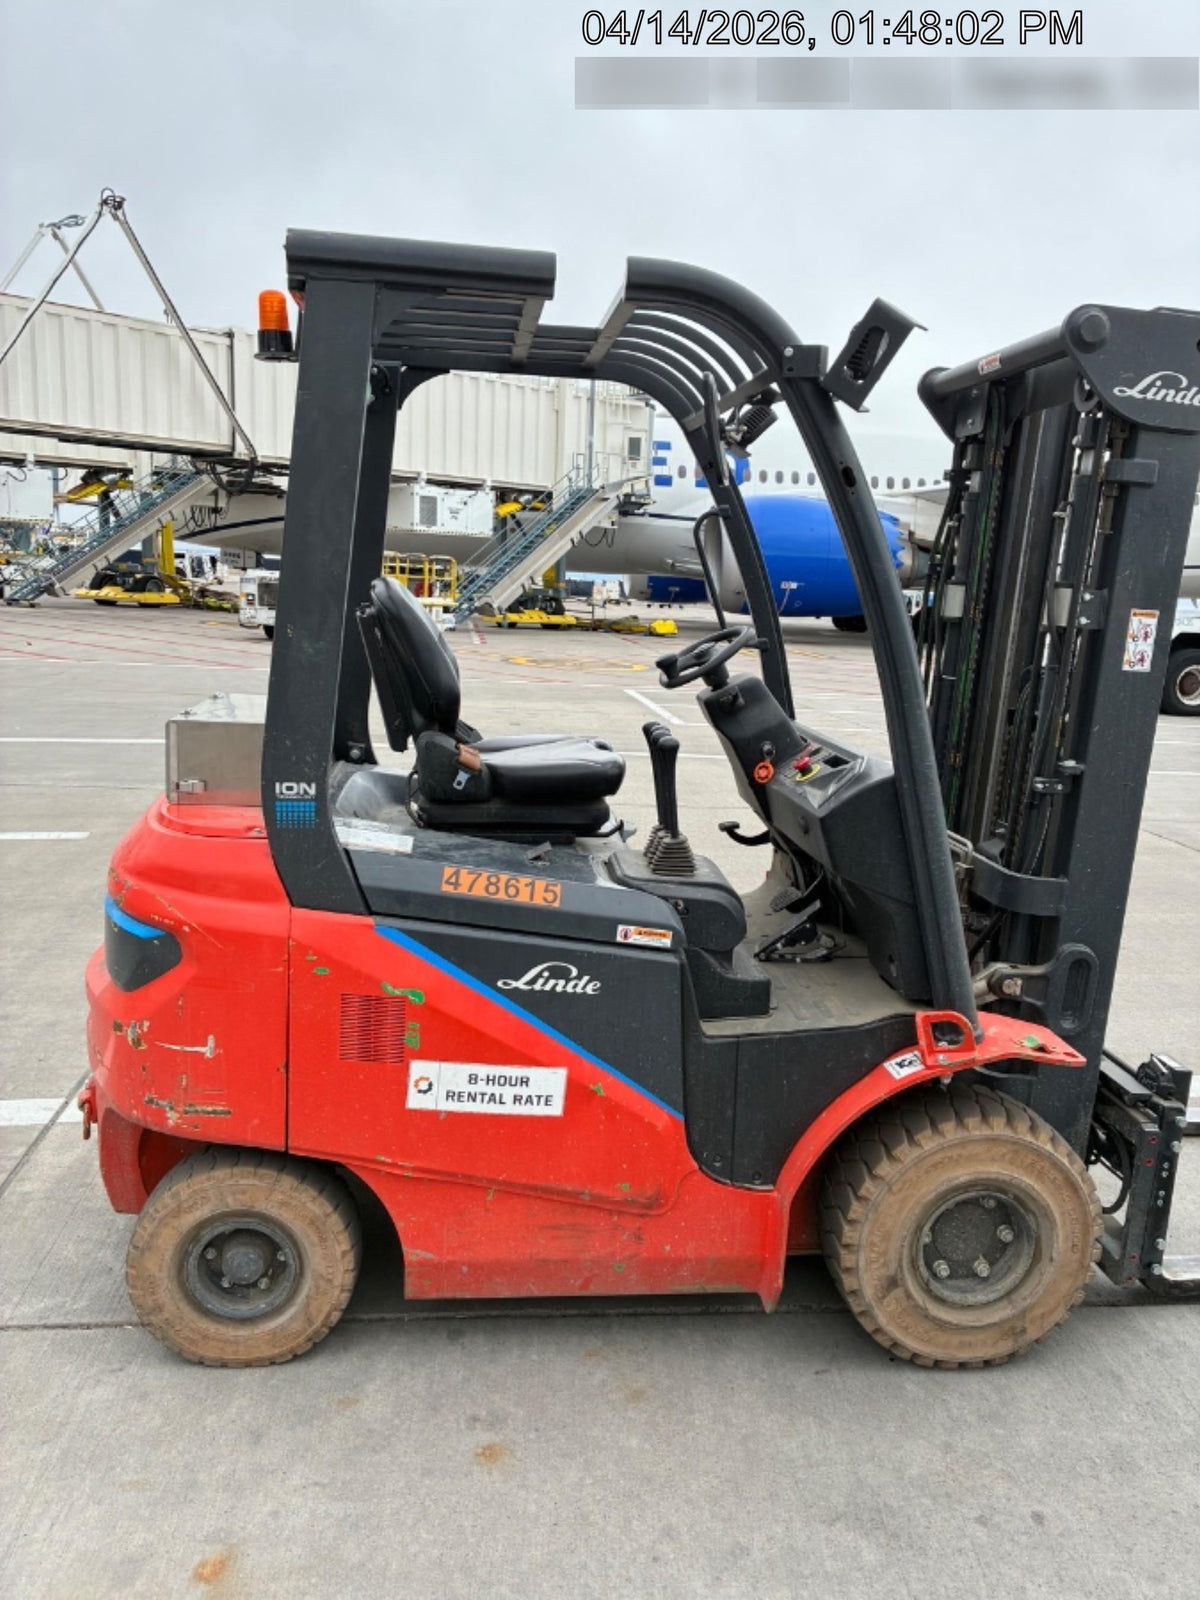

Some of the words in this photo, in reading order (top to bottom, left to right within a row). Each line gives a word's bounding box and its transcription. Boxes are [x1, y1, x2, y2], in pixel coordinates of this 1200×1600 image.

[275, 782, 316, 795] ION
[444, 867, 559, 904] 478615
[496, 961, 602, 995] Linde
[467, 1073, 531, 1088] 8-HOUR
[445, 1090, 507, 1105] RENTAL
[512, 1093, 554, 1107] RATE
